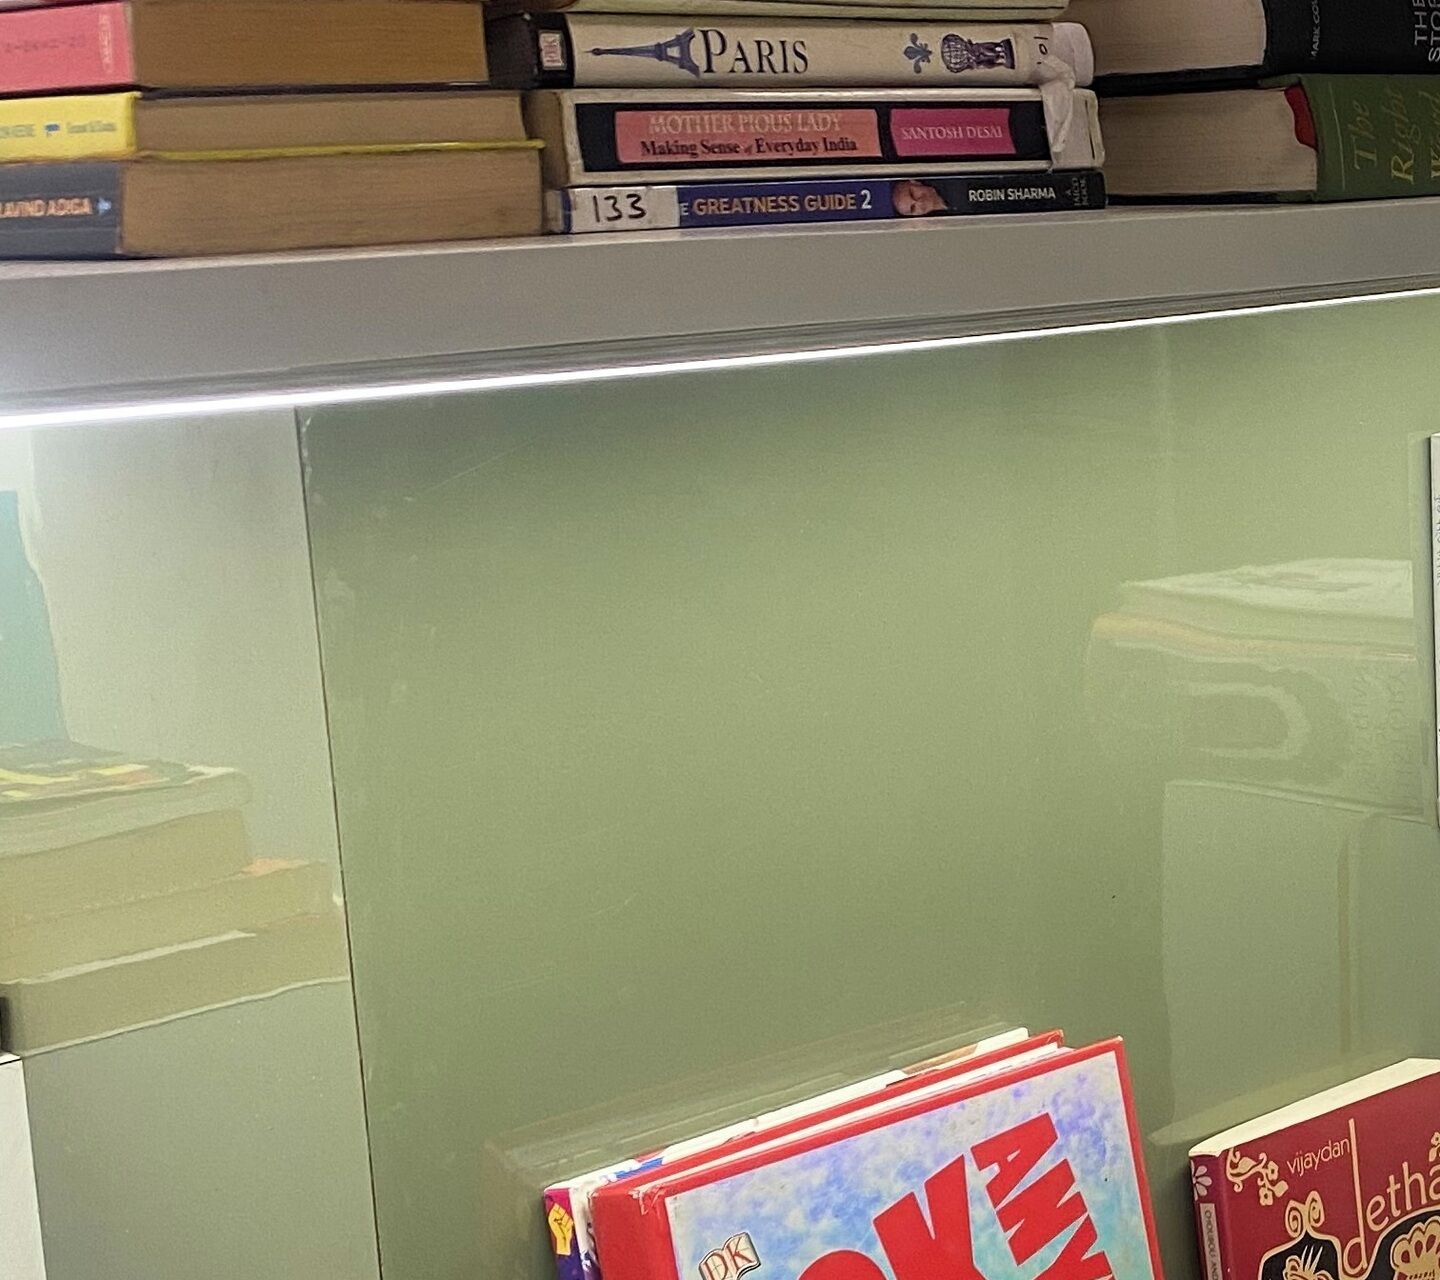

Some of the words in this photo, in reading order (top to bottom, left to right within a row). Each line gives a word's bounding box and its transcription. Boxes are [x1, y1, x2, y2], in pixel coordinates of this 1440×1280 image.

[701, 29, 809, 74] PARIS
[650, 113, 733, 135] MOTHER
[735, 112, 794, 133] PIOUS
[798, 112, 844, 132] LADY
[901, 128, 964, 141] SANTOSH
[967, 126, 1003, 139] DESAI
[1354, 99, 1378, 169] The
[1384, 82, 1422, 185] Right
[640, 140, 698, 158] Making
[700, 139, 741, 155] Sense
[755, 138, 820, 156] Everyday
[823, 138, 858, 153] India
[592, 193, 648, 223] 133
[692, 197, 800, 216] GREATNESS
[804, 194, 857, 212] GUIDE
[860, 189, 873, 210] 2
[968, 189, 1005, 202] ROBIN
[1007, 186, 1057, 201] SHARMA
[1287, 1137, 1350, 1176] vijaydan
[1204, 1209, 1217, 1266] CHOUBOLI
